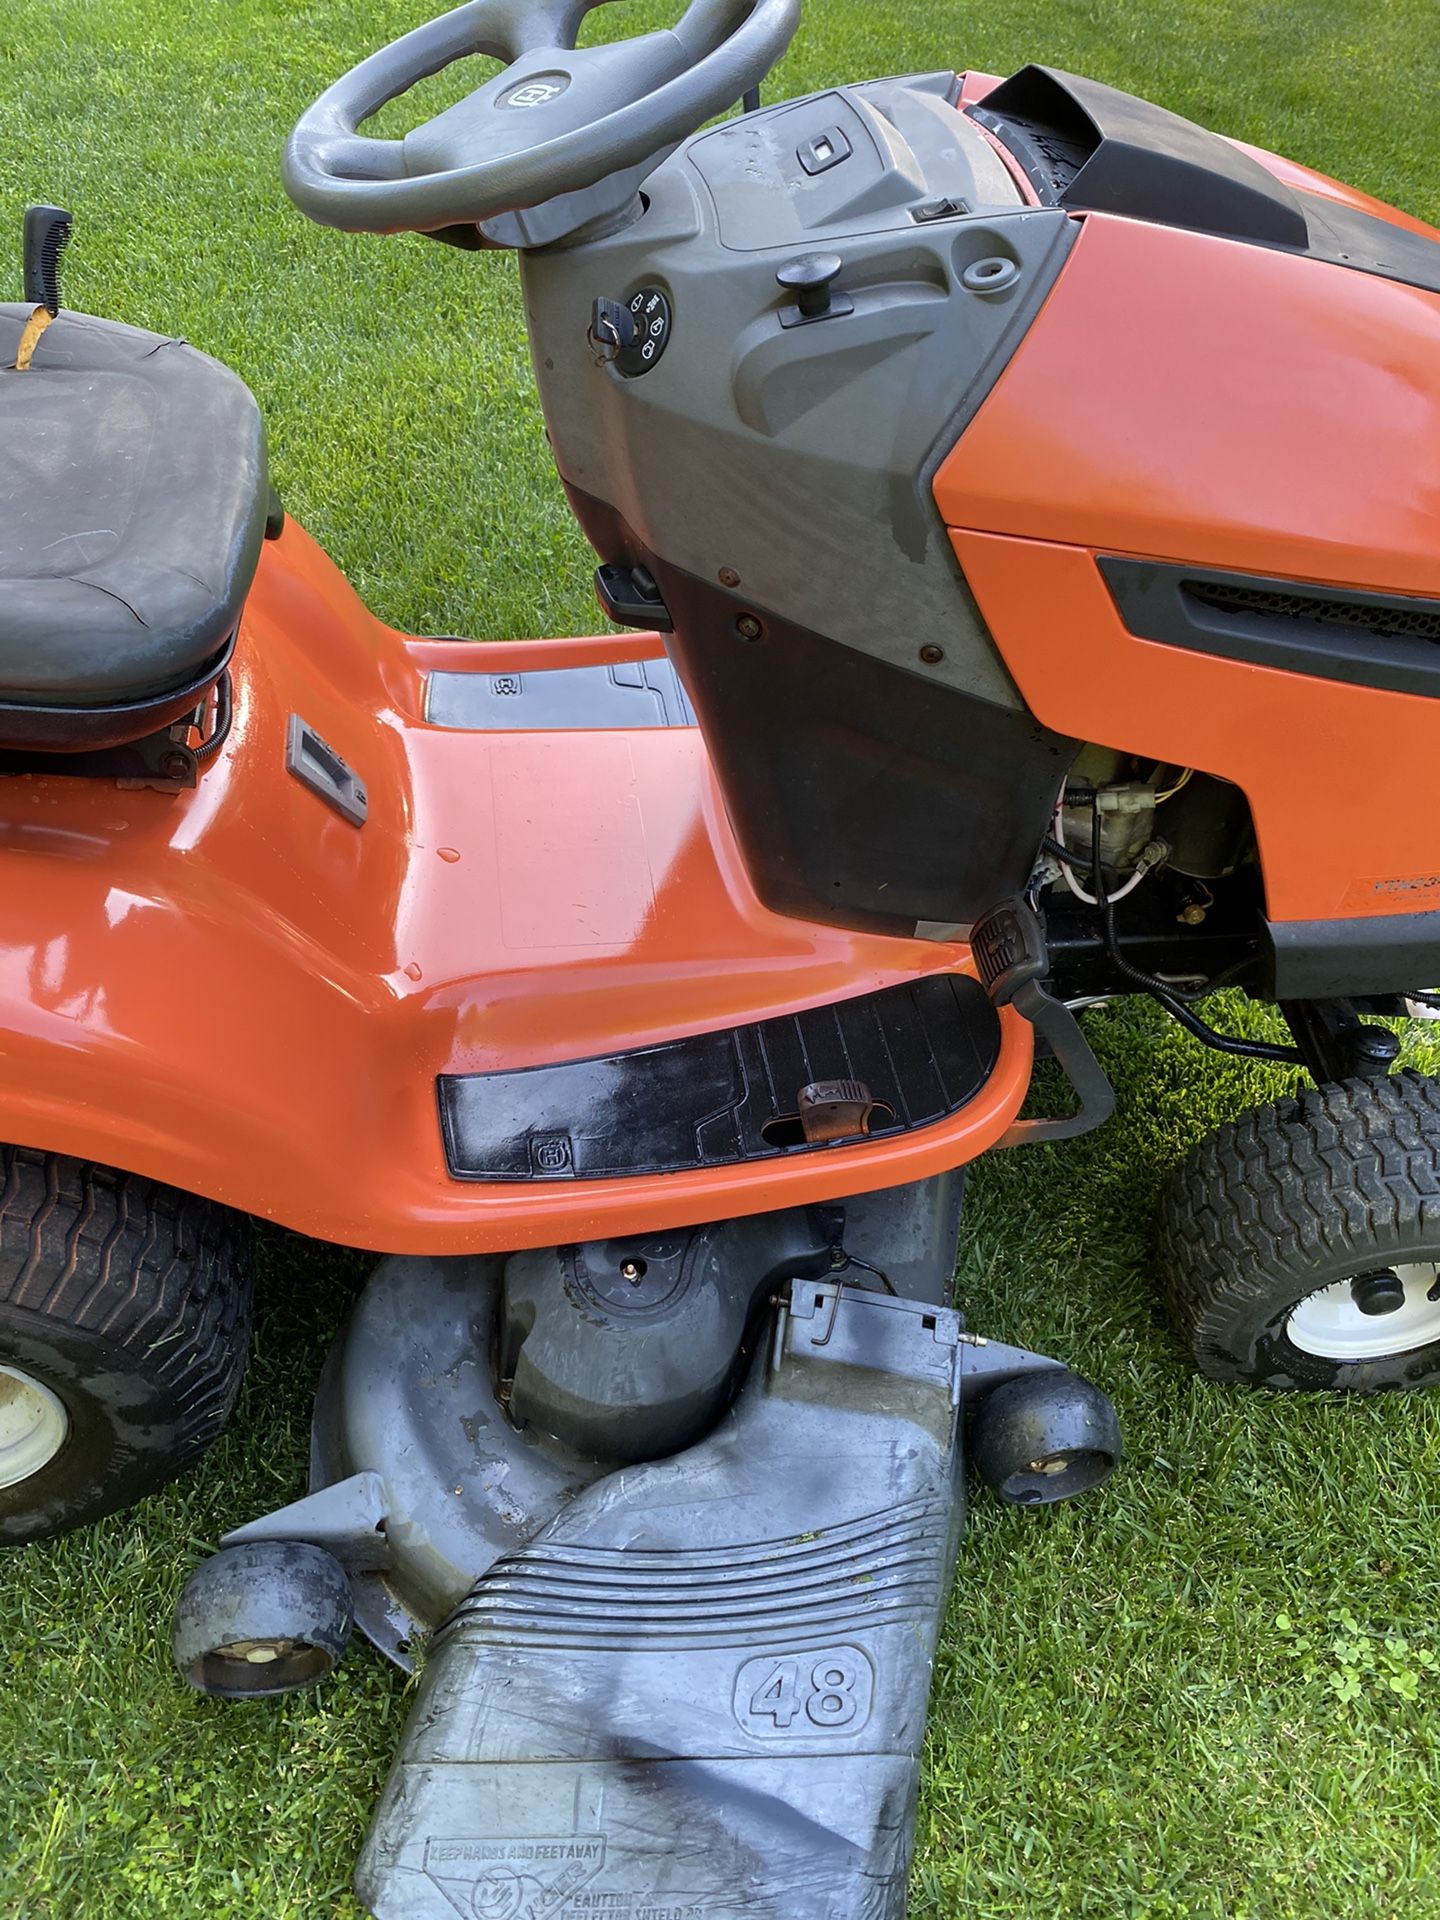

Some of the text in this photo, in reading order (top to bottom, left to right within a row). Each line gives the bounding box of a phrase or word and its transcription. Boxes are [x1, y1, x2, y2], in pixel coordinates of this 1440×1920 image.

[749, 1659, 858, 1729] 48
[429, 1844, 599, 1861] KEEP HANDS AND FEET AWAY
